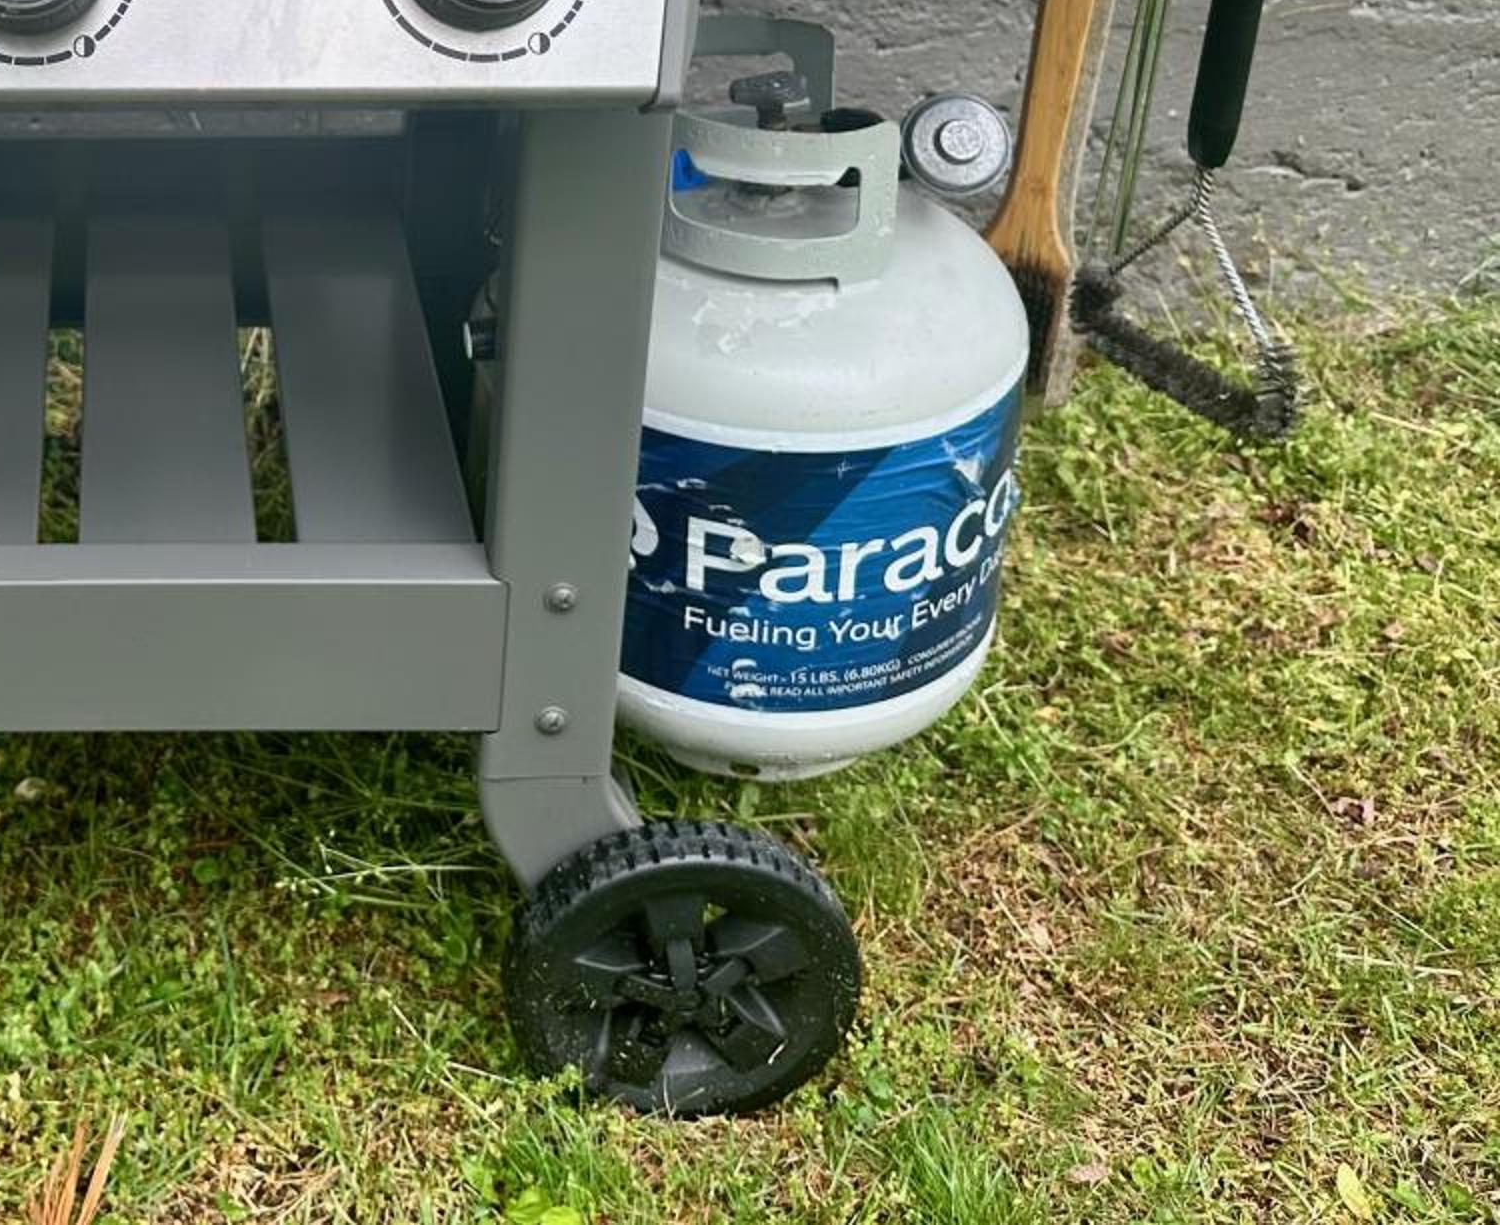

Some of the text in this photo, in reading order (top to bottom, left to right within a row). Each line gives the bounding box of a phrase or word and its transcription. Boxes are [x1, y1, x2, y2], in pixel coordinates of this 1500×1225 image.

[685, 467, 1013, 604] Paraco
[684, 606, 817, 651] Fueling
[829, 614, 905, 645] Your
[911, 575, 978, 631] Every
[790, 672, 807, 684] 15
[811, 670, 841, 685] LBS.
[843, 657, 901, 682] (6.80KG)
[826, 675, 887, 696] IMPORTANT
